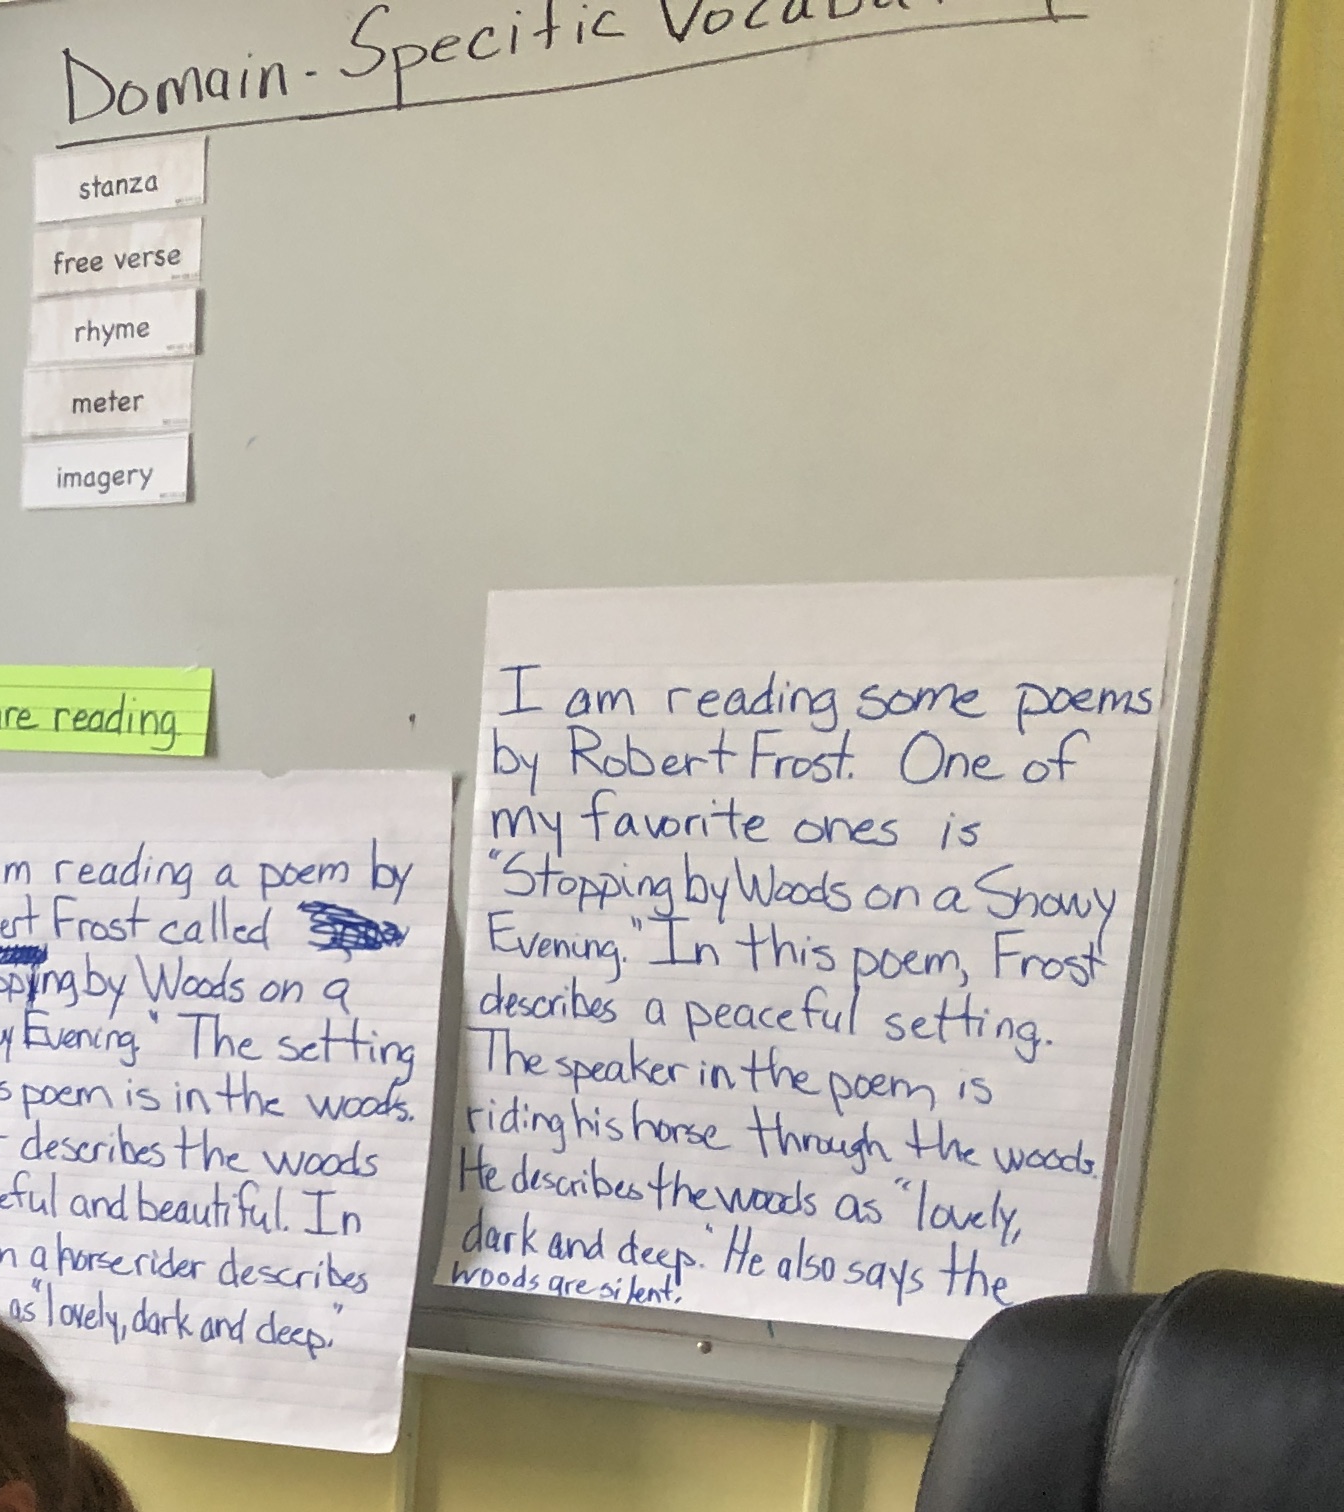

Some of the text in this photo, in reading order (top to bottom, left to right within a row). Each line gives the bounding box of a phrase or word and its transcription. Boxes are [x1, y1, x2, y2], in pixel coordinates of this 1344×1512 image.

[79, 174, 158, 200] stanza
[54, 247, 182, 275] free verse
[74, 320, 150, 347] rhyme
[72, 391, 144, 414] meter
[56, 467, 153, 494] imagery
[498, 664, 1153, 735] I am reading some poems
[492, 727, 1090, 796] by Robert Frost. One of
[492, 789, 980, 857] my favorite ones is
[55, 841, 193, 899] reading
[216, 865, 239, 888] a
[260, 860, 349, 902] poem
[371, 838, 414, 904] by
[685, 852, 728, 925] by
[735, 865, 852, 912] Woods
[864, 884, 920, 911] on
[933, 885, 967, 912] a
[972, 864, 1117, 947] Snowy
[53, 896, 151, 942] Frost
[159, 895, 270, 949] called
[649, 916, 719, 966] In
[735, 924, 836, 973] this
[853, 945, 968, 988] poem,
[993, 930, 1106, 984] Frost
[85, 952, 127, 1020] by
[136, 953, 245, 1003] Woods
[259, 977, 303, 1002] on
[323, 977, 351, 1014] a
[479, 975, 1054, 1063] describes a peaceful setting.
[177, 1012, 263, 1062] The
[278, 1017, 415, 1087] setting
[468, 1027, 994, 1118] The speaker in the poem is
[22, 1082, 112, 1119] poem
[127, 1078, 160, 1111] is
[176, 1078, 211, 1114] in
[221, 1072, 284, 1119] the
[306, 1075, 415, 1122] woods.
[22, 1120, 167, 1168] describes
[175, 1126, 249, 1174] the
[263, 1140, 379, 1178] woods
[466, 1097, 566, 1154] riding
[571, 1098, 623, 1141] his
[632, 1105, 732, 1150] horse
[748, 1107, 891, 1174] through
[905, 1121, 980, 1167] the
[71, 1187, 125, 1218] and
[137, 1179, 289, 1232] beautiful.
[302, 1189, 361, 1236] In
[458, 1147, 506, 1196] He
[513, 1153, 644, 1202] describes
[648, 1161, 716, 1212] the
[716, 1180, 818, 1217] woods
[836, 1196, 882, 1223] as
[30, 1247, 48, 1272] a
[218, 1253, 369, 1294] describes
[451, 1261, 684, 1305] woods are silent.
[460, 1211, 537, 1256] dark
[550, 1230, 604, 1260] and
[723, 1225, 764, 1276] He
[778, 1238, 836, 1280] also
[843, 1260, 925, 1305] says
[939, 1243, 1012, 1307] the
[11, 1299, 36, 1323] as
[132, 1308, 194, 1336] dark
[201, 1313, 244, 1344] and
